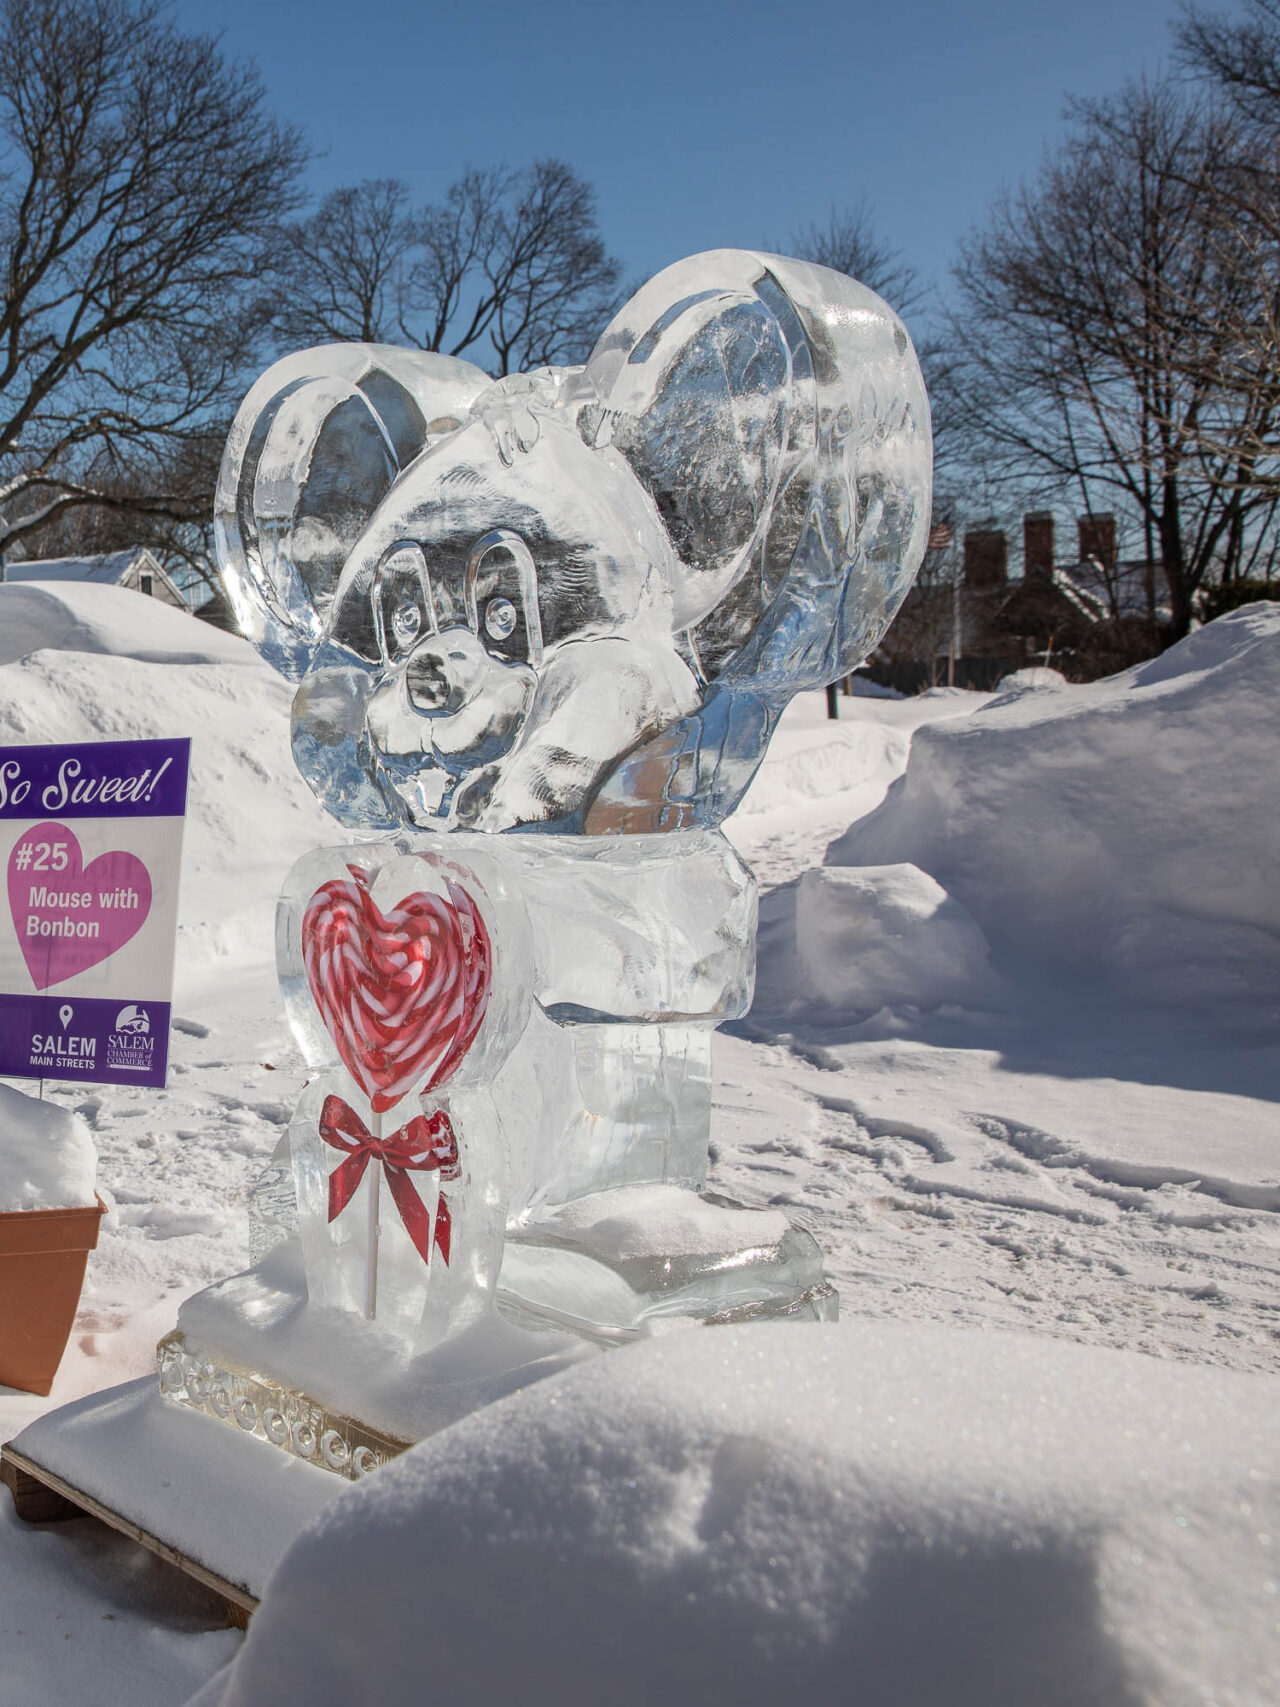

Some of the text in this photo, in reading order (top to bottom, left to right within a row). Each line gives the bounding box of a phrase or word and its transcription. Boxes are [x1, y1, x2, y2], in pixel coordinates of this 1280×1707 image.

[42, 757, 173, 811] Sweet!
[15, 842, 69, 871] #25
[28, 886, 139, 909] Mouse with
[26, 915, 100, 938] Bonbon
[31, 1034, 96, 1057] SALEM
[107, 1034, 155, 1050] SALEM
[30, 1056, 95, 1069] MAIN STREETS
[106, 1057, 153, 1067] COMMERCE
[107, 1050, 144, 1058] CHAMBER
